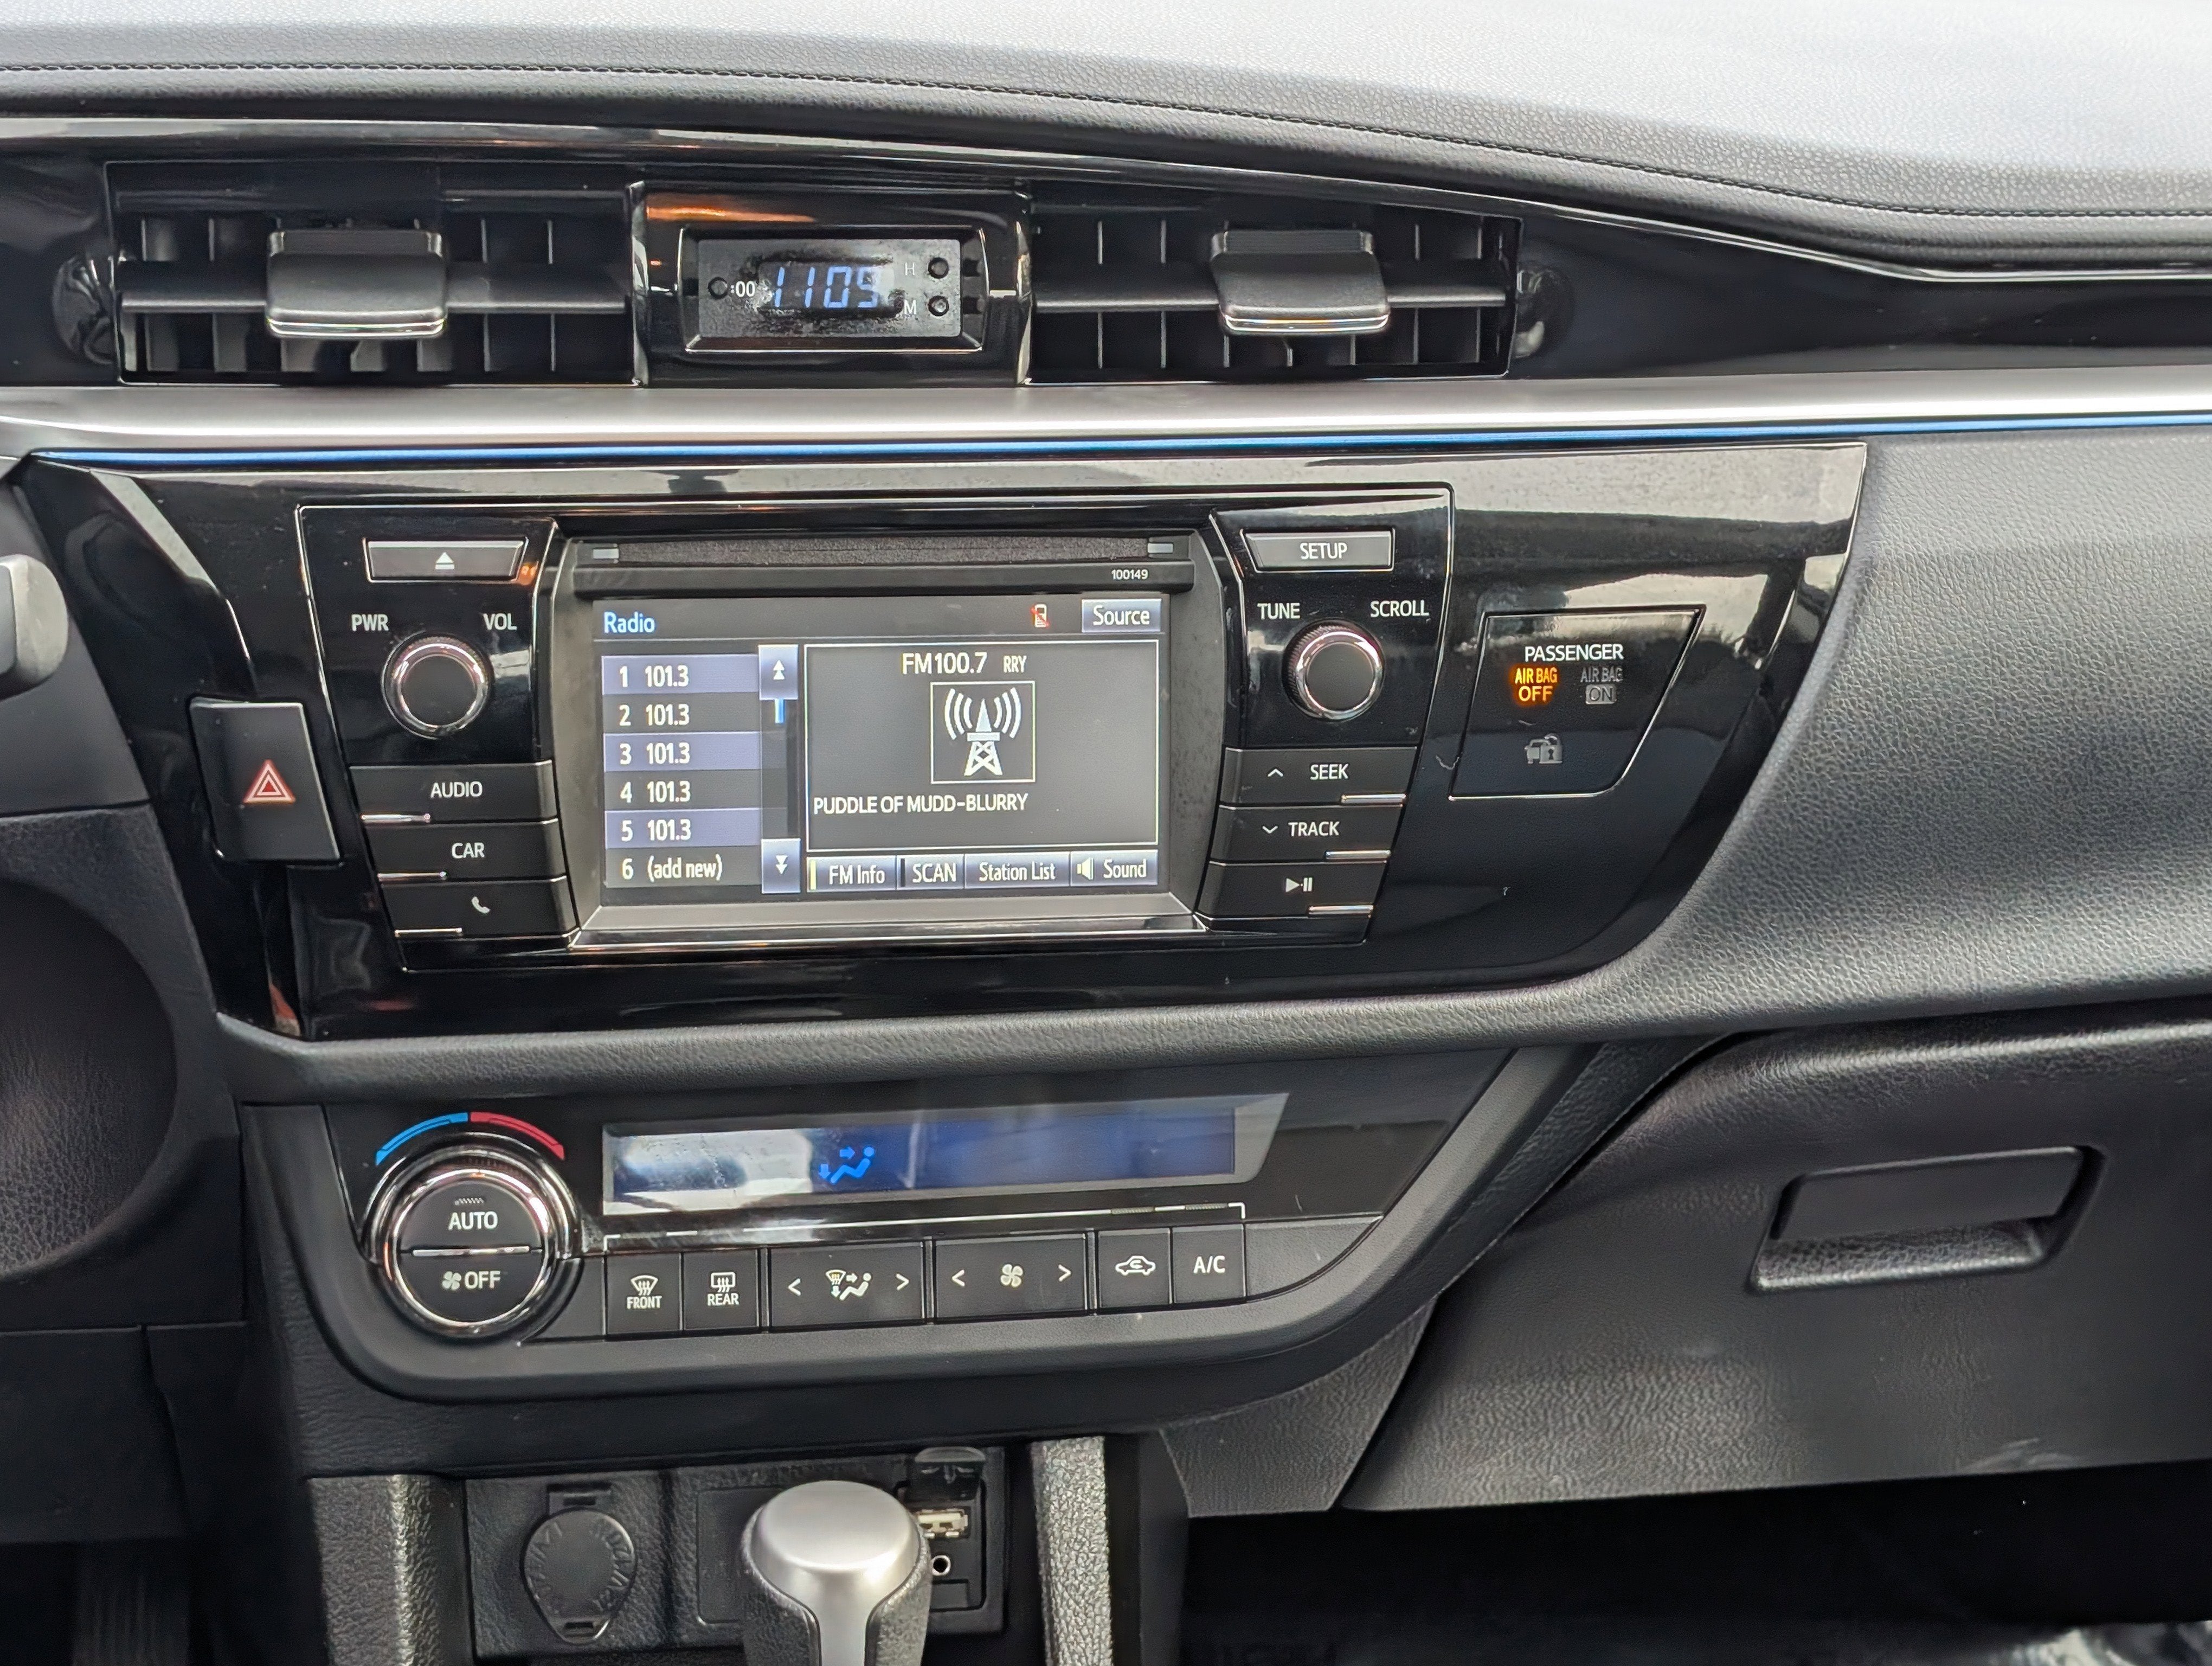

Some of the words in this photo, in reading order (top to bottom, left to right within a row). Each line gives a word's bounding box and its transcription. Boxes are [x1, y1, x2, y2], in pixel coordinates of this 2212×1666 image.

[905, 263, 915, 276] H
[730, 280, 756, 297] :00
[904, 300, 917, 315] M
[1300, 542, 1348, 560] SETUP
[1111, 569, 1148, 580] 100149
[1092, 605, 1150, 626] Source
[1257, 603, 1301, 619] TUNE
[1370, 600, 1429, 618] SCROLL
[351, 614, 389, 632] PWR
[483, 613, 517, 631] VOL
[603, 612, 655, 633] Radio
[1525, 643, 1624, 662] PASSENGER
[1003, 656, 1027, 673] RRY
[619, 667, 628, 688] 1
[645, 665, 689, 687] 101.3
[1514, 667, 1534, 684] AIR
[1536, 667, 1558, 683] BAG
[1580, 667, 1599, 683] AIR
[1602, 667, 1623, 682] BAG
[1518, 685, 1553, 702] OFF
[1589, 687, 1613, 701] ON
[619, 705, 631, 726] 2
[646, 704, 690, 725] 101.3
[620, 744, 631, 765] 3
[647, 742, 690, 764] 101.3
[1310, 764, 1349, 780] SEEK
[430, 781, 483, 798] AUDIO
[620, 782, 632, 803] 4
[647, 781, 691, 802] 101.3
[814, 796, 877, 815] PUDDLE
[881, 796, 903, 813] OF
[907, 793, 1028, 813] MUDD-BLURRY
[621, 821, 633, 841] 5
[648, 819, 691, 840] 101.3
[1288, 822, 1340, 836] TRACK
[451, 842, 485, 858] CAR
[622, 858, 633, 880] 6
[647, 856, 681, 883] (add
[686, 854, 722, 881] new)
[829, 866, 853, 885] FM
[857, 865, 885, 885] Info
[912, 863, 956, 883] SCAN
[979, 863, 1027, 882] Station
[1031, 862, 1056, 880] List
[1103, 861, 1146, 878] Sound
[448, 1212, 498, 1231] AUTO
[1193, 1255, 1226, 1274] A/C
[464, 1271, 501, 1290] OFF
[627, 1296, 662, 1309] FRONT
[707, 1292, 739, 1306] REAR
